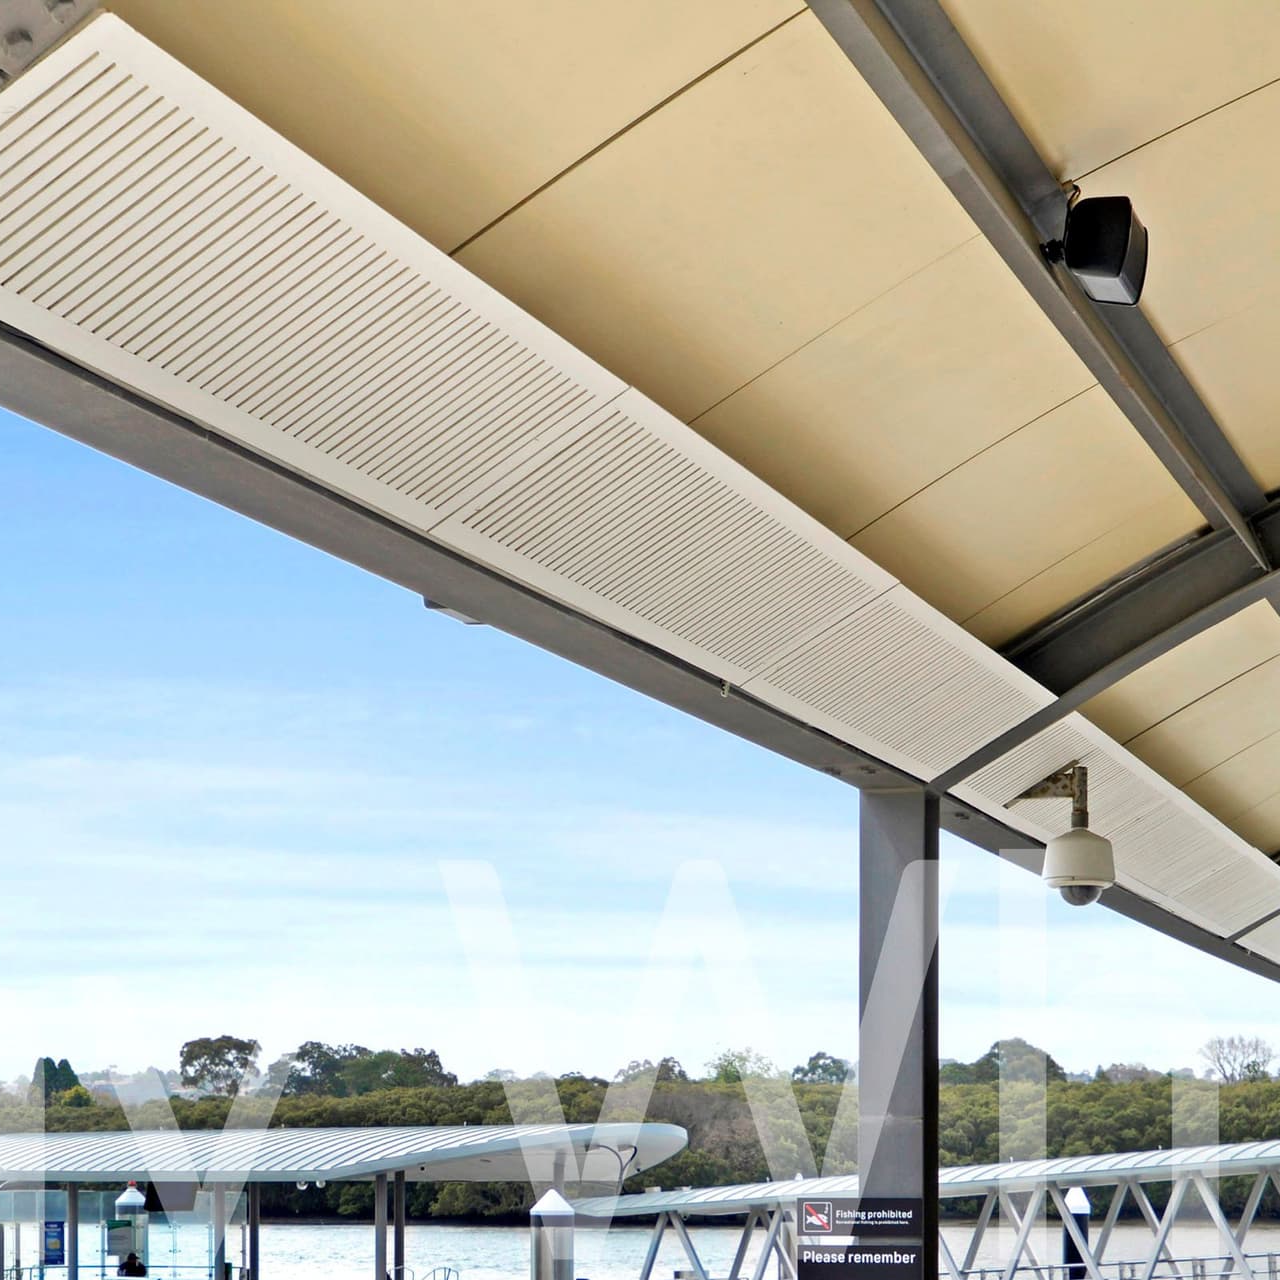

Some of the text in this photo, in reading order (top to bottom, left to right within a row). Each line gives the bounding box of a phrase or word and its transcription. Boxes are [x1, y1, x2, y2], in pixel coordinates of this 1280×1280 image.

[835, 1209, 913, 1220] Fishing prohibited
[803, 1251, 916, 1264] Please remember
